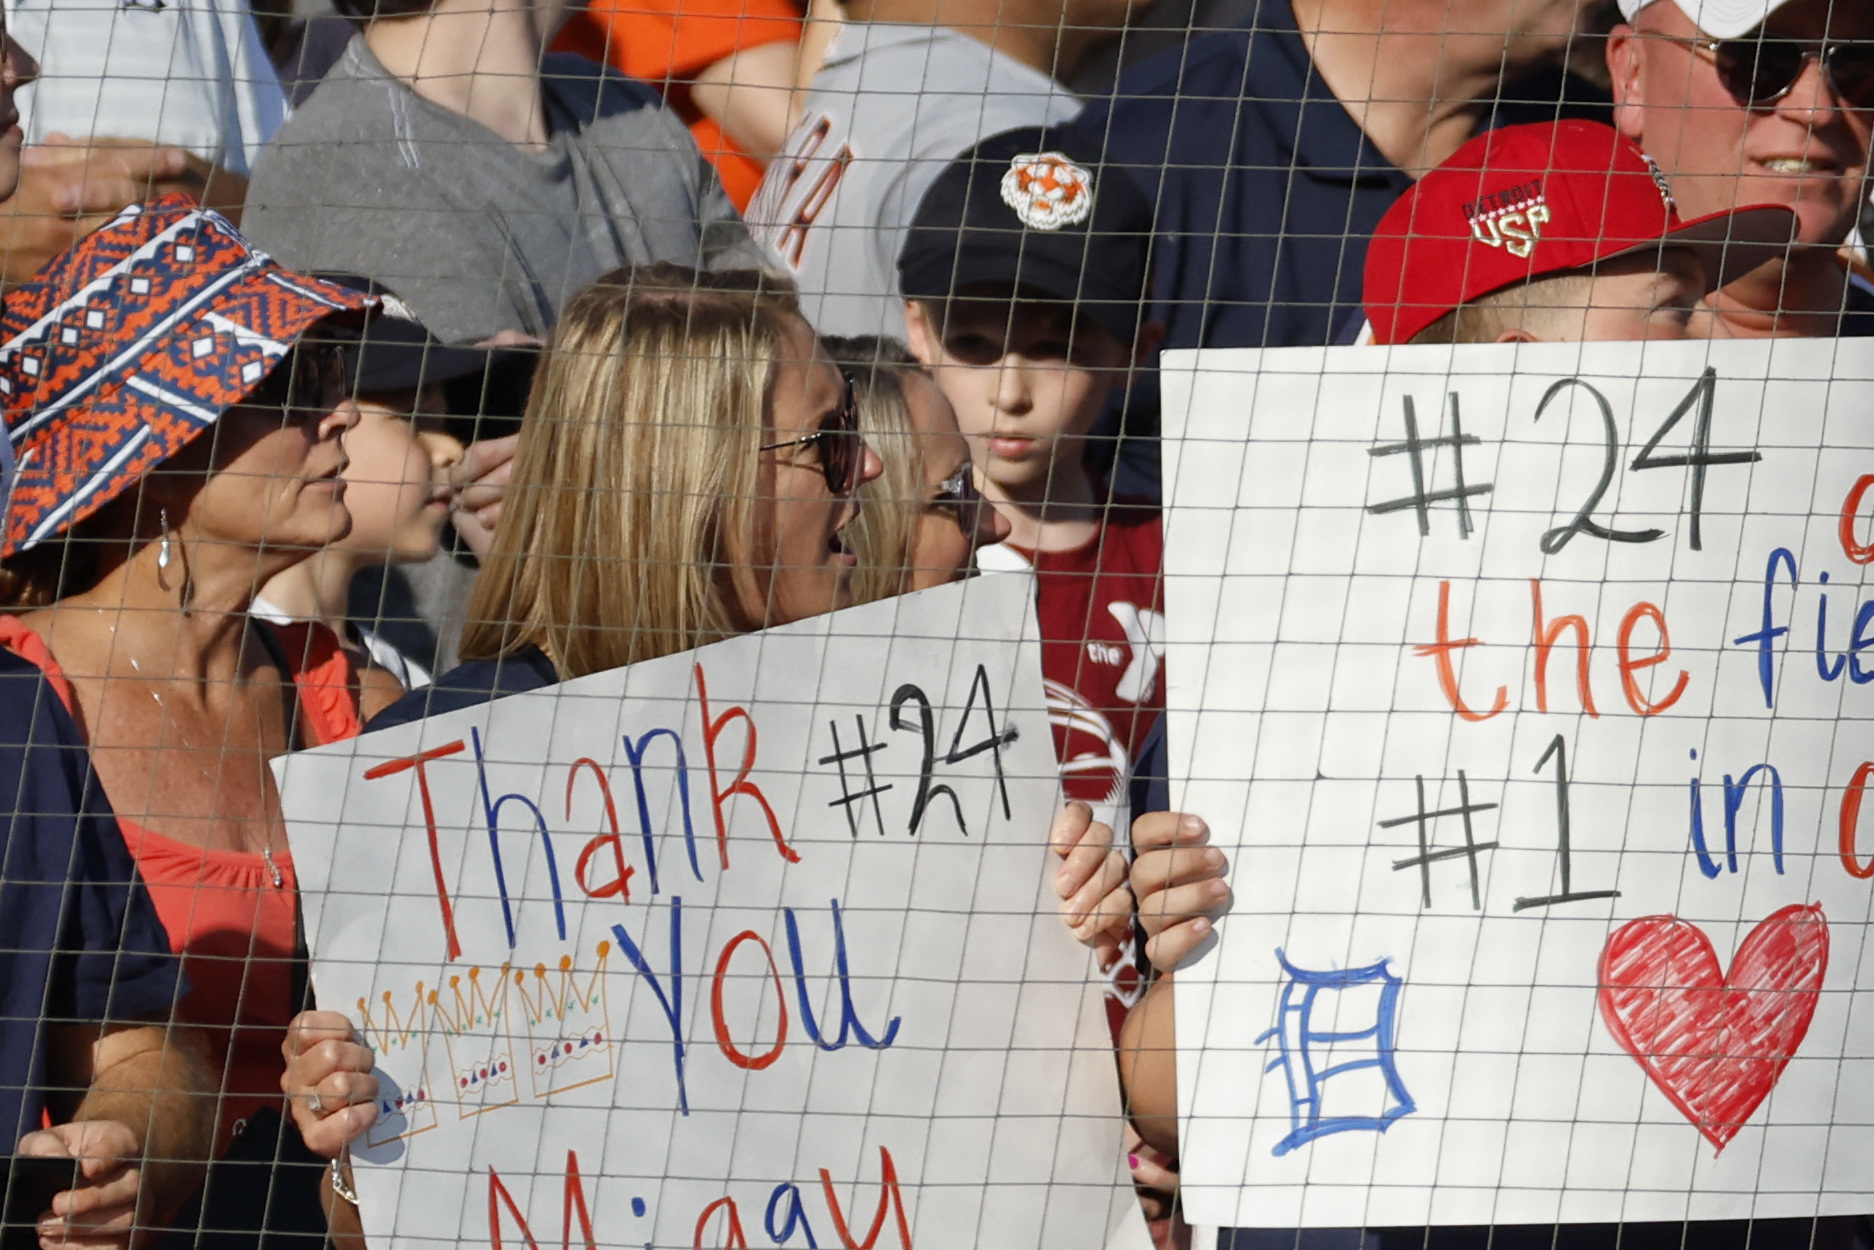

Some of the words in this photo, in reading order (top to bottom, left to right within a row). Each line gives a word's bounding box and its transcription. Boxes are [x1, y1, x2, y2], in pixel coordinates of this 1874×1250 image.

[1367, 366, 1762, 554] #24
[1087, 642, 1123, 666] the
[1412, 578, 1690, 722] the
[365, 661, 802, 962] Thank
[818, 663, 1020, 836] #24
[1378, 734, 1622, 910] #1
[1690, 748, 1785, 879] in
